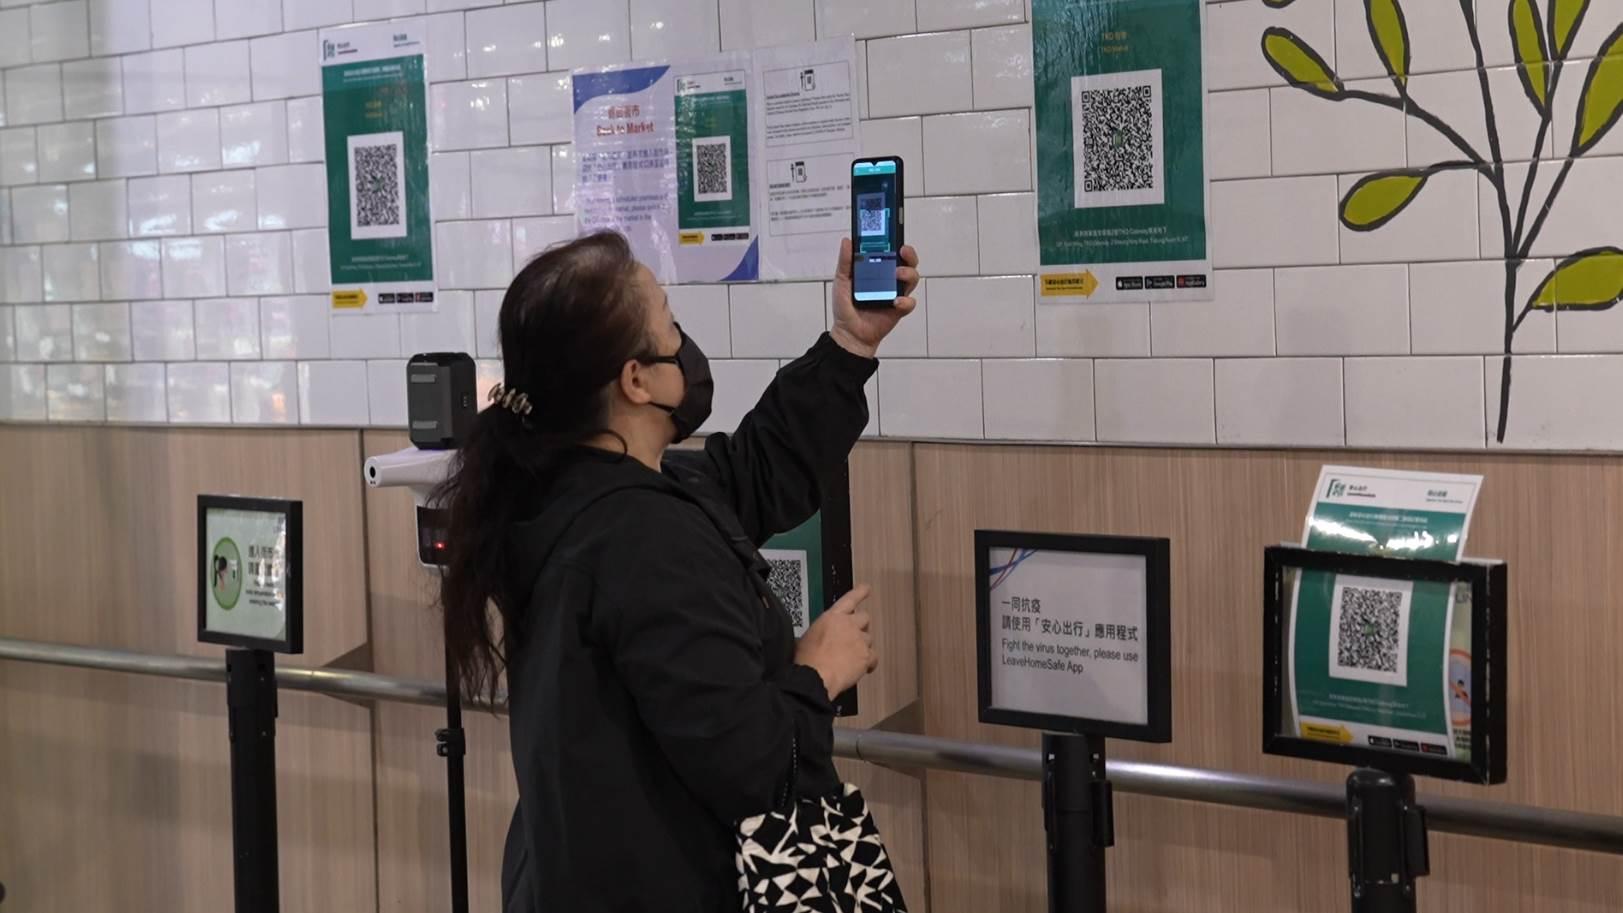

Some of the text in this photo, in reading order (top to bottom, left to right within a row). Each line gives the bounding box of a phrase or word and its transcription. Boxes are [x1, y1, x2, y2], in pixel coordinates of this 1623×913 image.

[626, 120, 654, 135] Market
[1001, 596, 1041, 613] 一同抗疫
[1002, 615, 1138, 641] 請使用「安心出行」應用程式
[1001, 638, 1139, 662] Fight the virus together, please use
[1001, 653, 1084, 675] LeaveHomeSafe App
